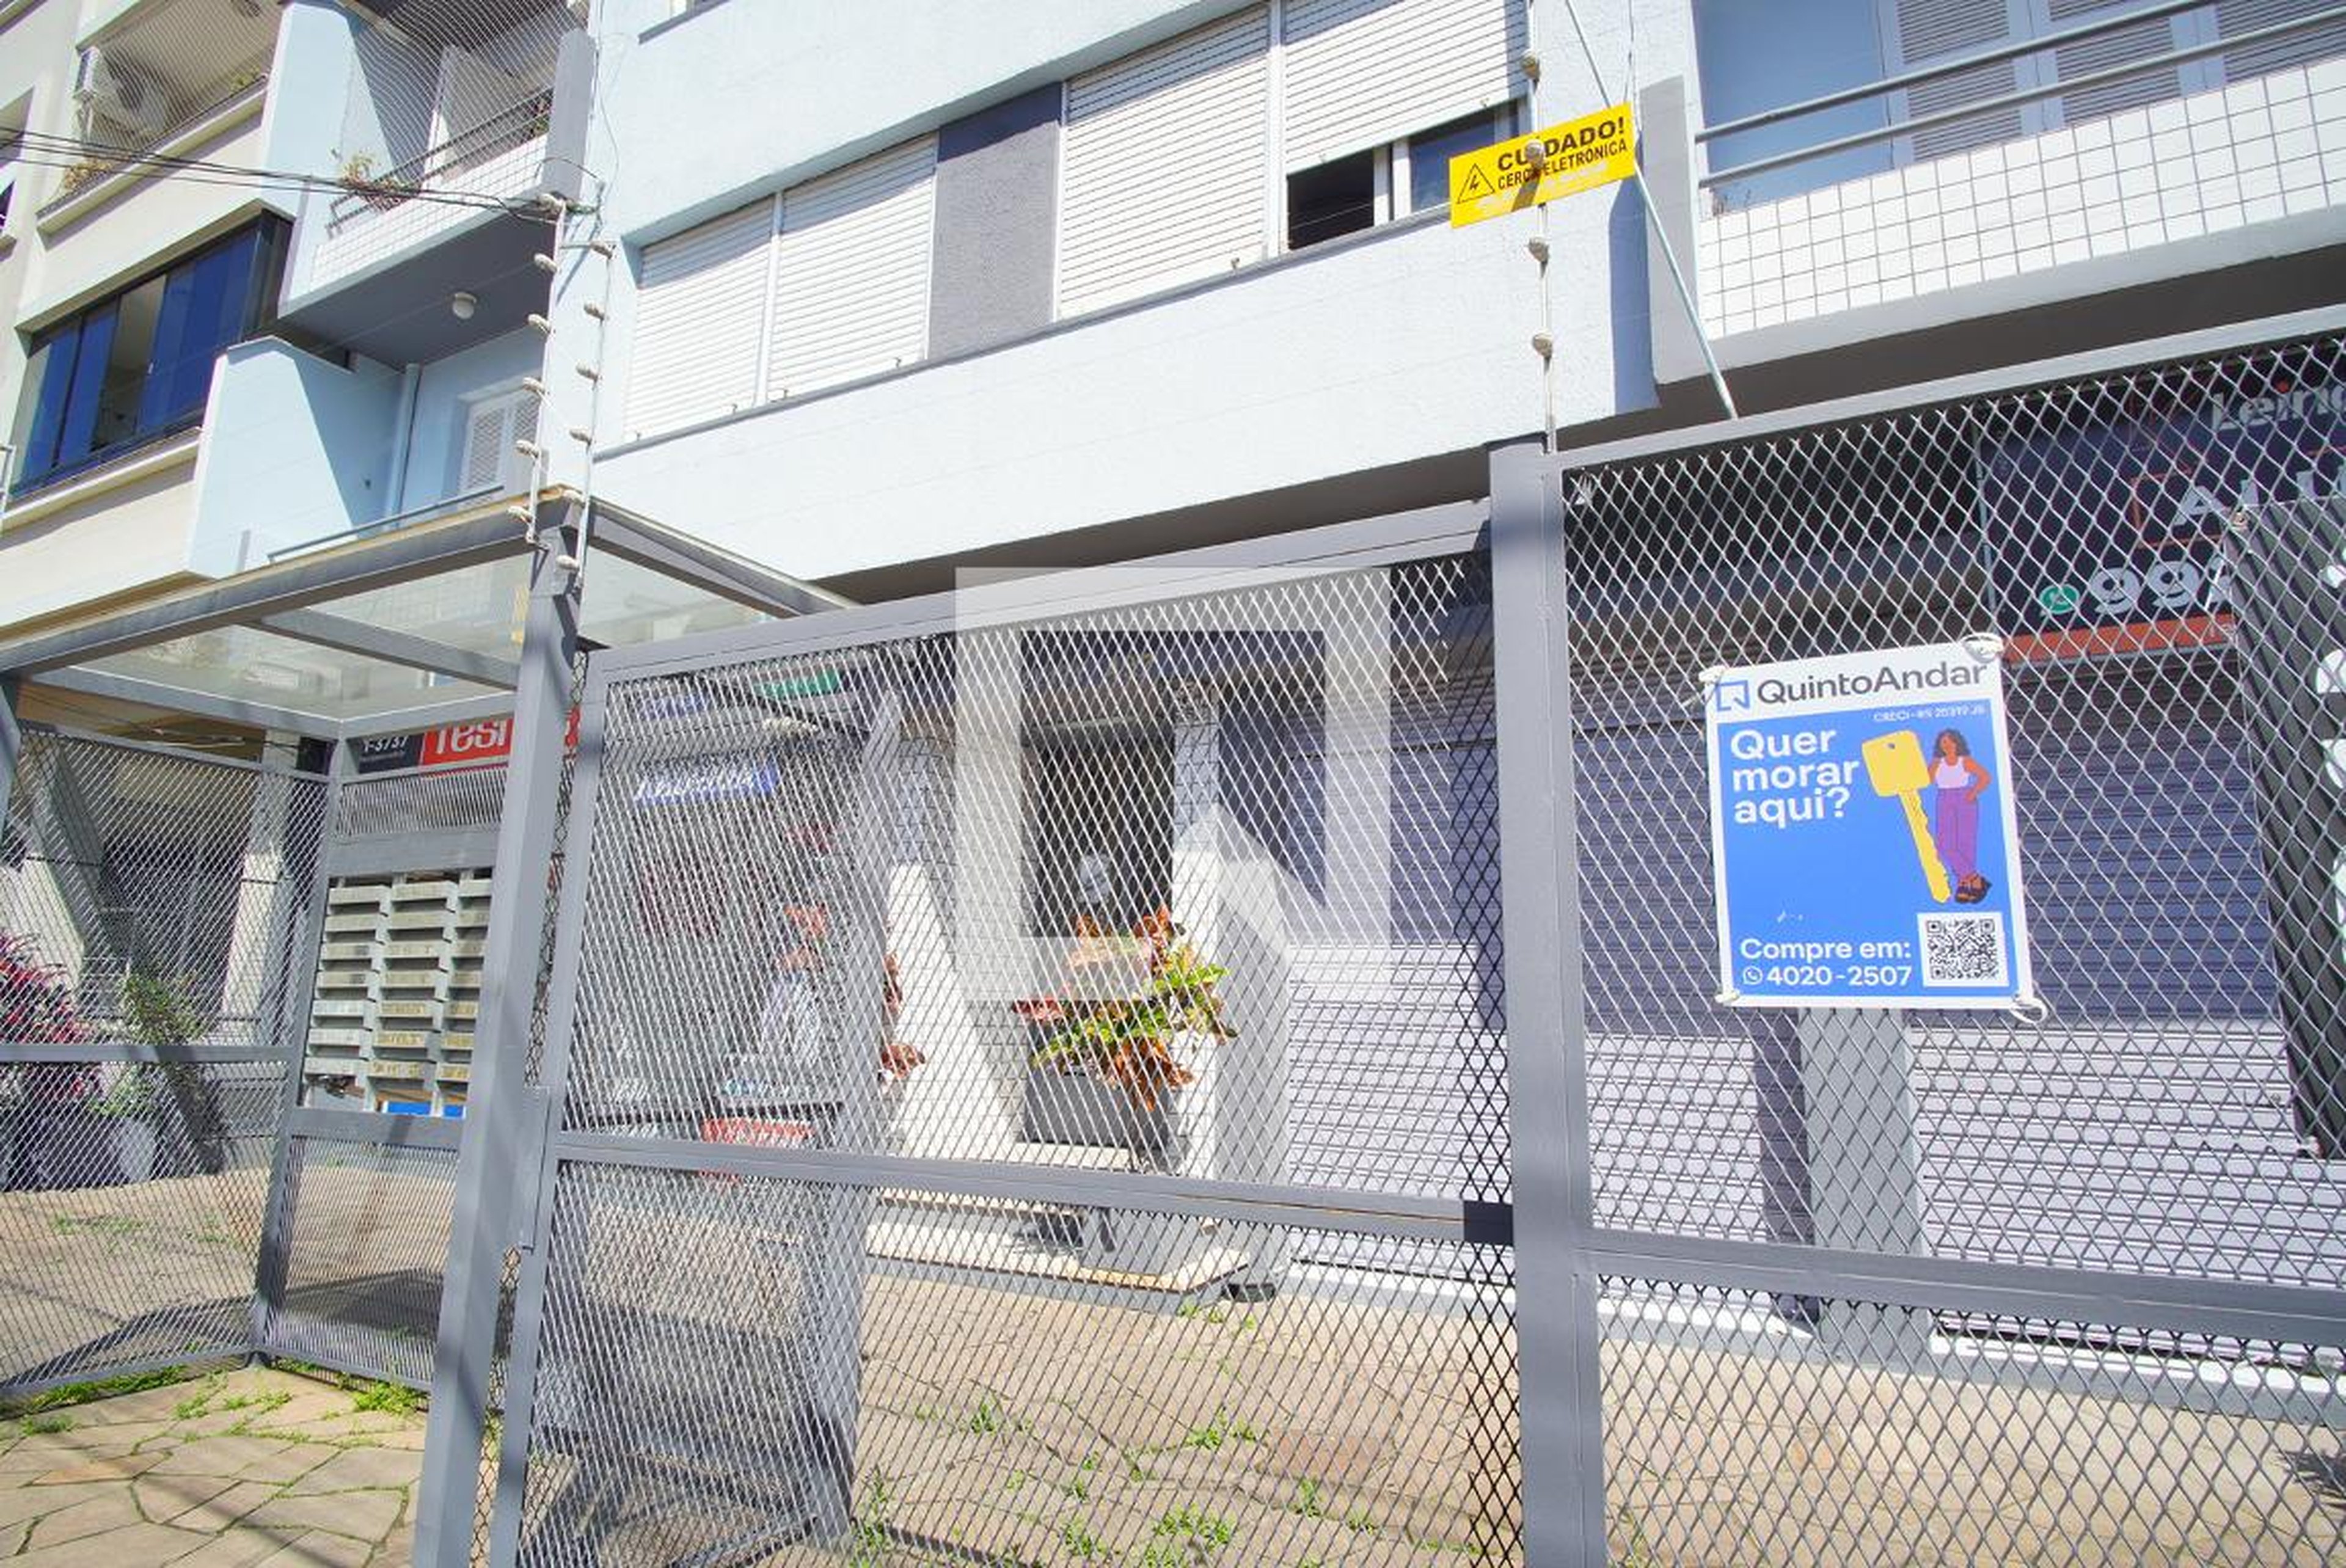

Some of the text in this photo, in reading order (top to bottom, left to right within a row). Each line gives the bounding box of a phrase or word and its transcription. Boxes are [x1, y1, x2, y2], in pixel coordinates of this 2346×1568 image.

[1498, 117, 1624, 171] CUDADO!
[1756, 662, 1988, 705] QuintoAndar
[1730, 729, 1836, 762] Quer
[1732, 760, 1859, 792] morar
[1733, 788, 1851, 829] aqui?
[1740, 938, 1912, 963] Compre em:
